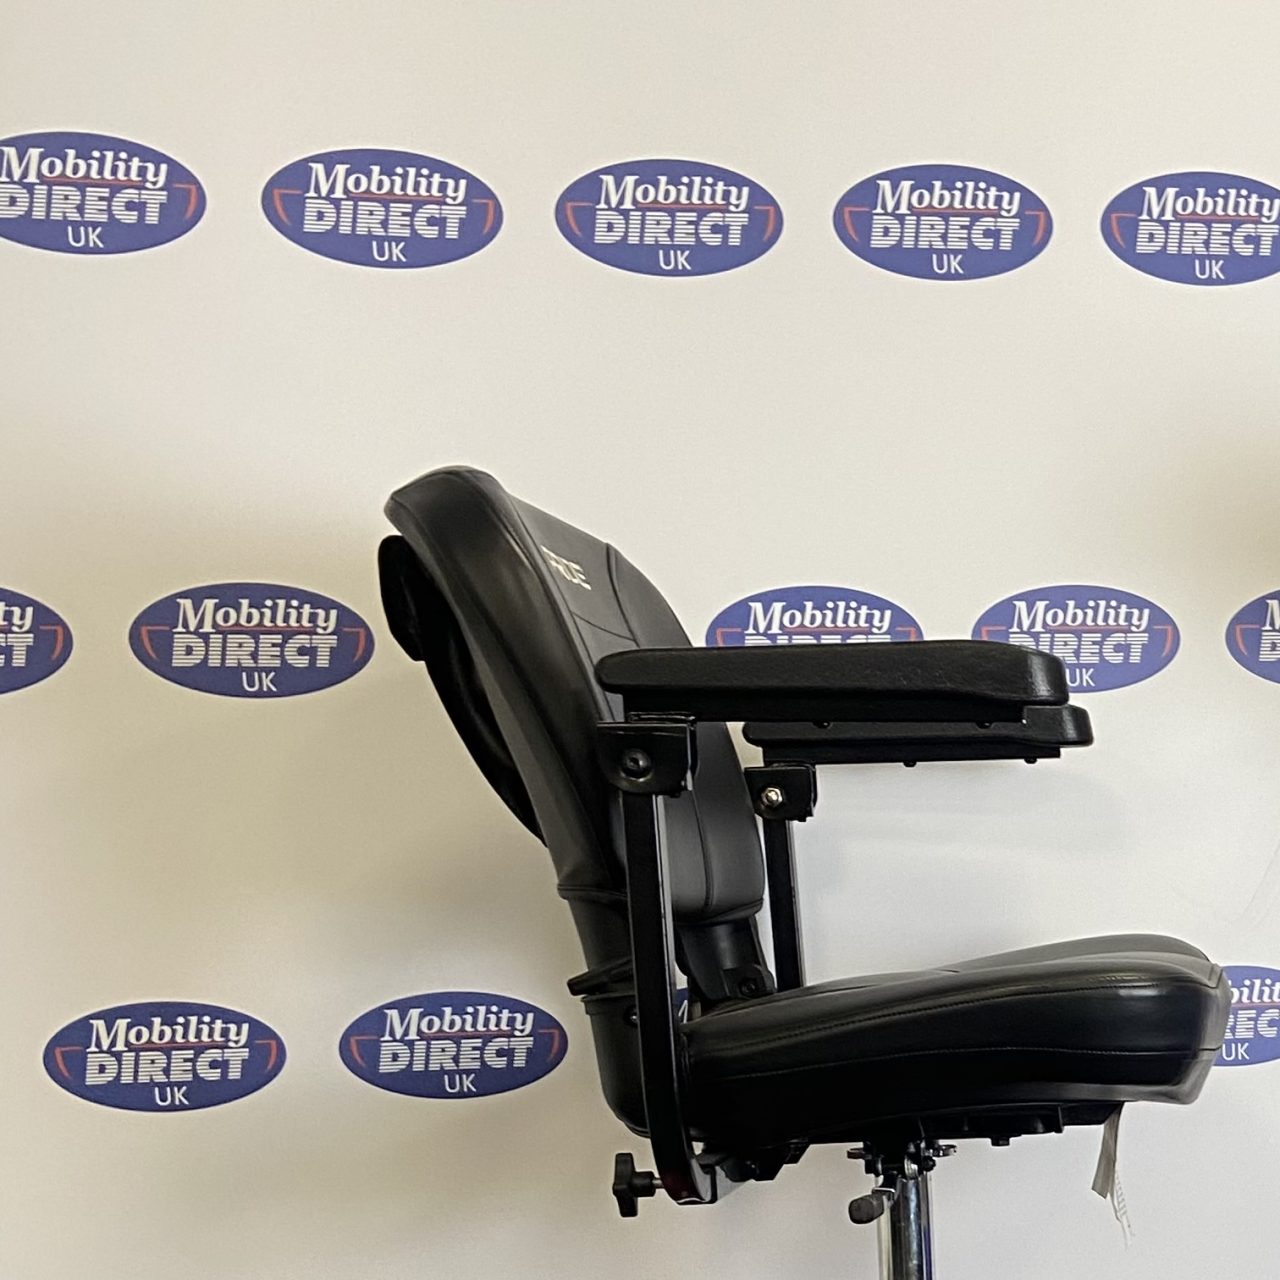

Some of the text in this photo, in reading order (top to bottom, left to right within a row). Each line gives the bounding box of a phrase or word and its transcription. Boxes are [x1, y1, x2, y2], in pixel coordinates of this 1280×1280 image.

[0, 146, 168, 189] Mobility
[307, 162, 467, 202] Mobility
[0, 184, 168, 224] DIRECT
[595, 175, 749, 212] Mobility
[874, 180, 1021, 216] Mobility
[1139, 188, 1280, 221] Mobility
[302, 199, 466, 239] DIRECT
[594, 209, 749, 246] DIRECT
[869, 216, 1019, 251] DIRECT
[68, 226, 104, 247] UK
[372, 240, 407, 262] UK
[1136, 221, 1280, 257] DIRECT
[658, 249, 692, 270] UK
[932, 254, 964, 275] UK
[1195, 258, 1225, 279] UK
[173, 598, 338, 632] Mobility
[744, 601, 892, 633] Mobility
[1009, 600, 1149, 632] Mobility
[172, 634, 338, 667] DIRECT
[242, 671, 277, 691] UK
[1066, 668, 1095, 686] UK
[88, 1015, 249, 1052] Mobility
[382, 1007, 534, 1039] Mobility
[85, 1049, 249, 1085] DIRECT
[379, 1037, 534, 1072] DIRECT
[1222, 1043, 1249, 1060] UK
[155, 1085, 189, 1106] UK
[444, 1073, 476, 1093] UK
